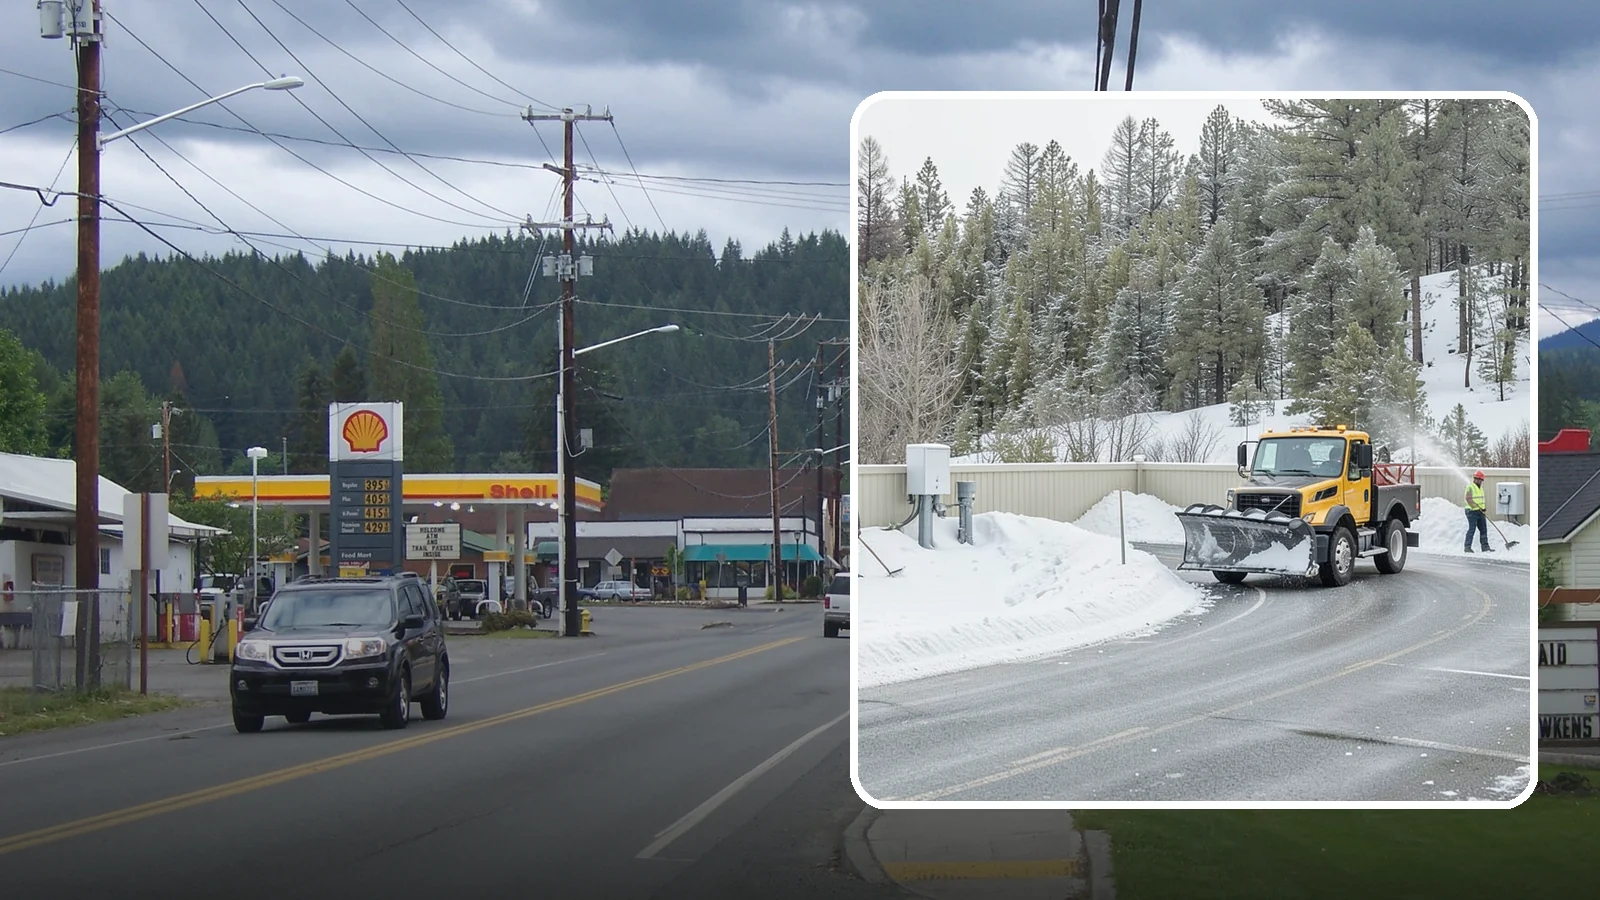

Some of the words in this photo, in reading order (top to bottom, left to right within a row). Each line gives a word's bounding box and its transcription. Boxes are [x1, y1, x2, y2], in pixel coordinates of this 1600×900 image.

[366, 480, 384, 490] 395
[490, 484, 548, 499] Shell
[366, 494, 384, 504] 405
[366, 508, 384, 518] 415
[366, 522, 384, 532] 429
[1539, 642, 1567, 665] AID
